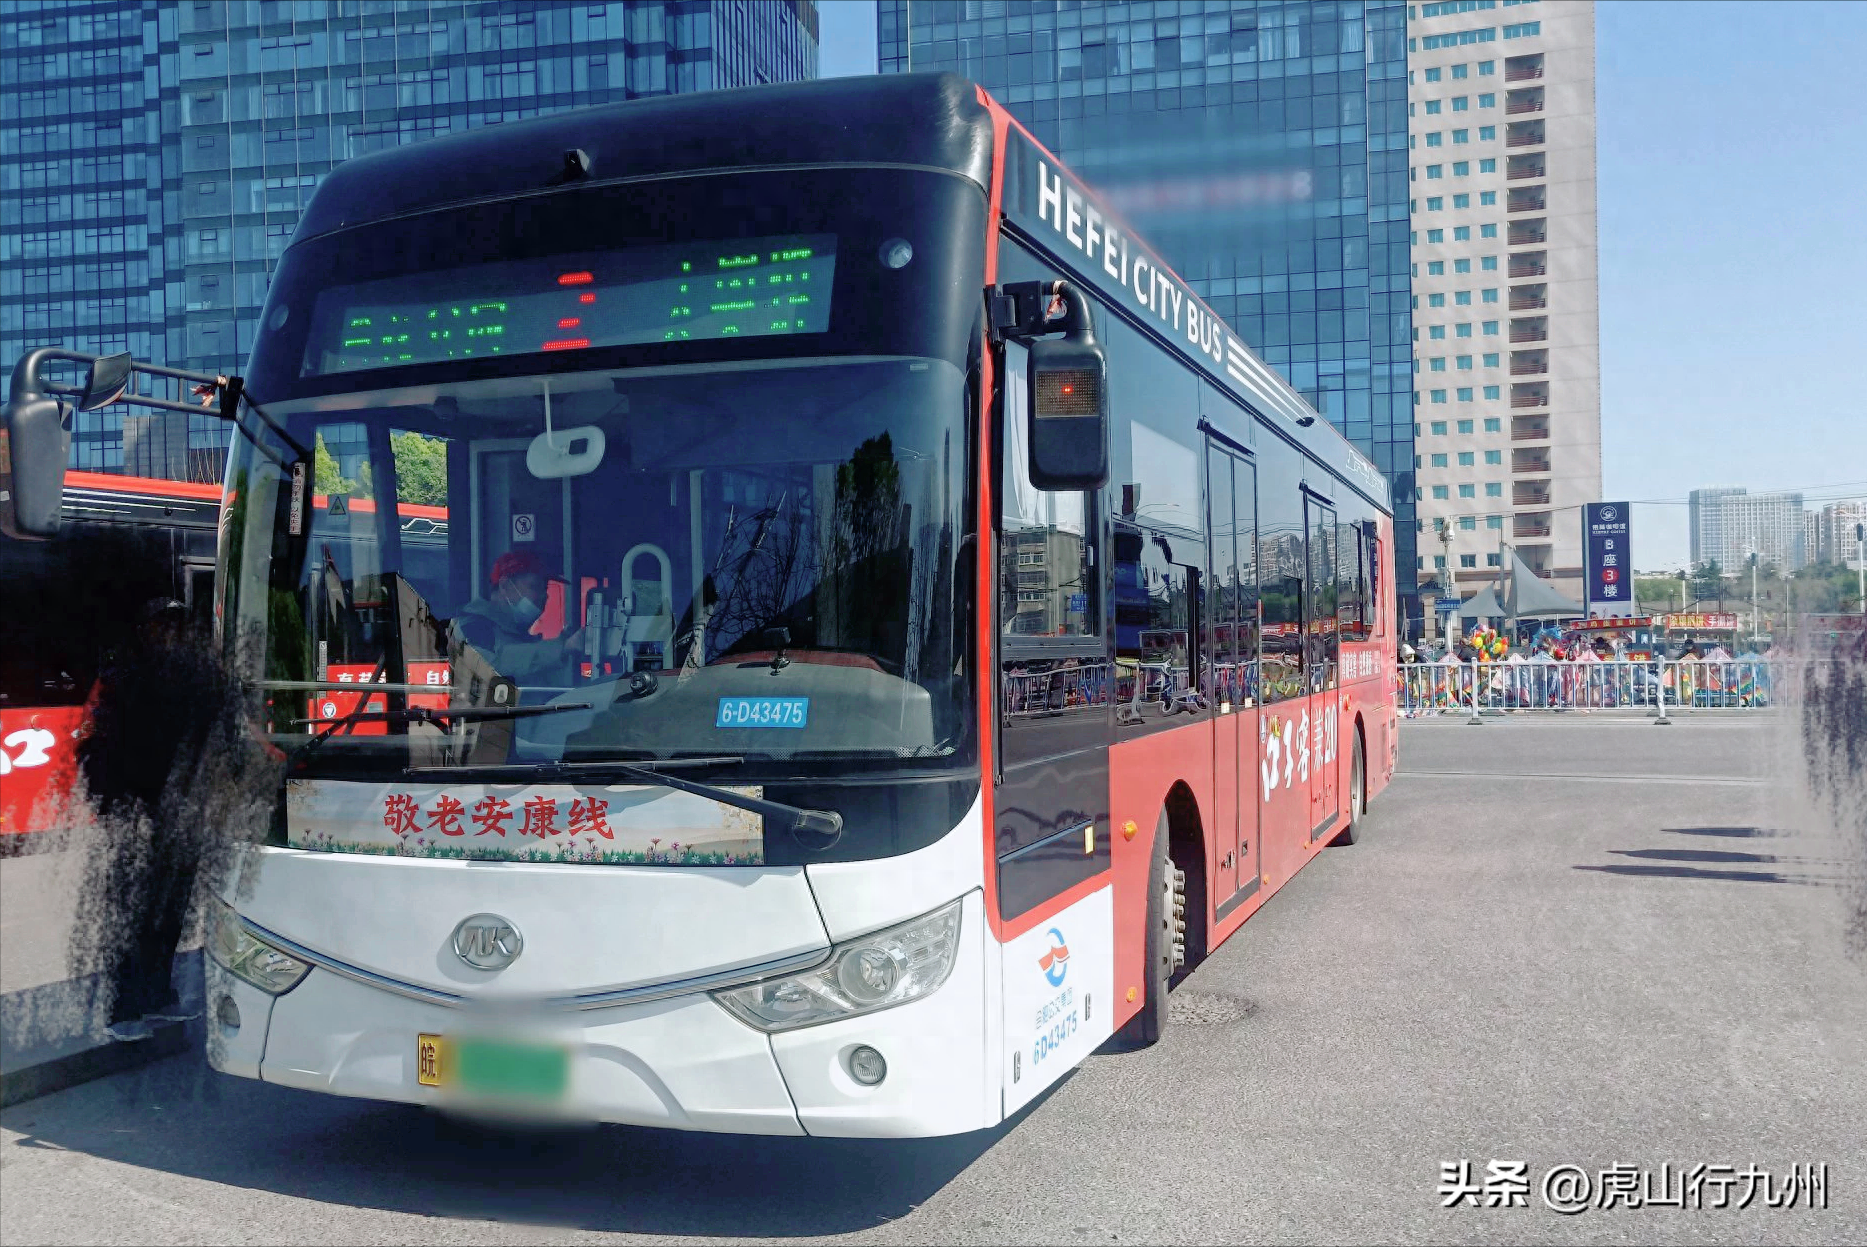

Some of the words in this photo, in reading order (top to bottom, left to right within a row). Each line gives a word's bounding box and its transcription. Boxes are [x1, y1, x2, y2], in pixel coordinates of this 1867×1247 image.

[1038, 160, 1128, 286] HEFEI
[1133, 255, 1183, 331] CITY
[1186, 301, 1223, 364] BUS
[721, 702, 804, 726] 6-D43475
[383, 794, 616, 840] 敬老安康线
[421, 1042, 436, 1078] 皖
[1033, 1010, 1077, 1065] 6D43475
